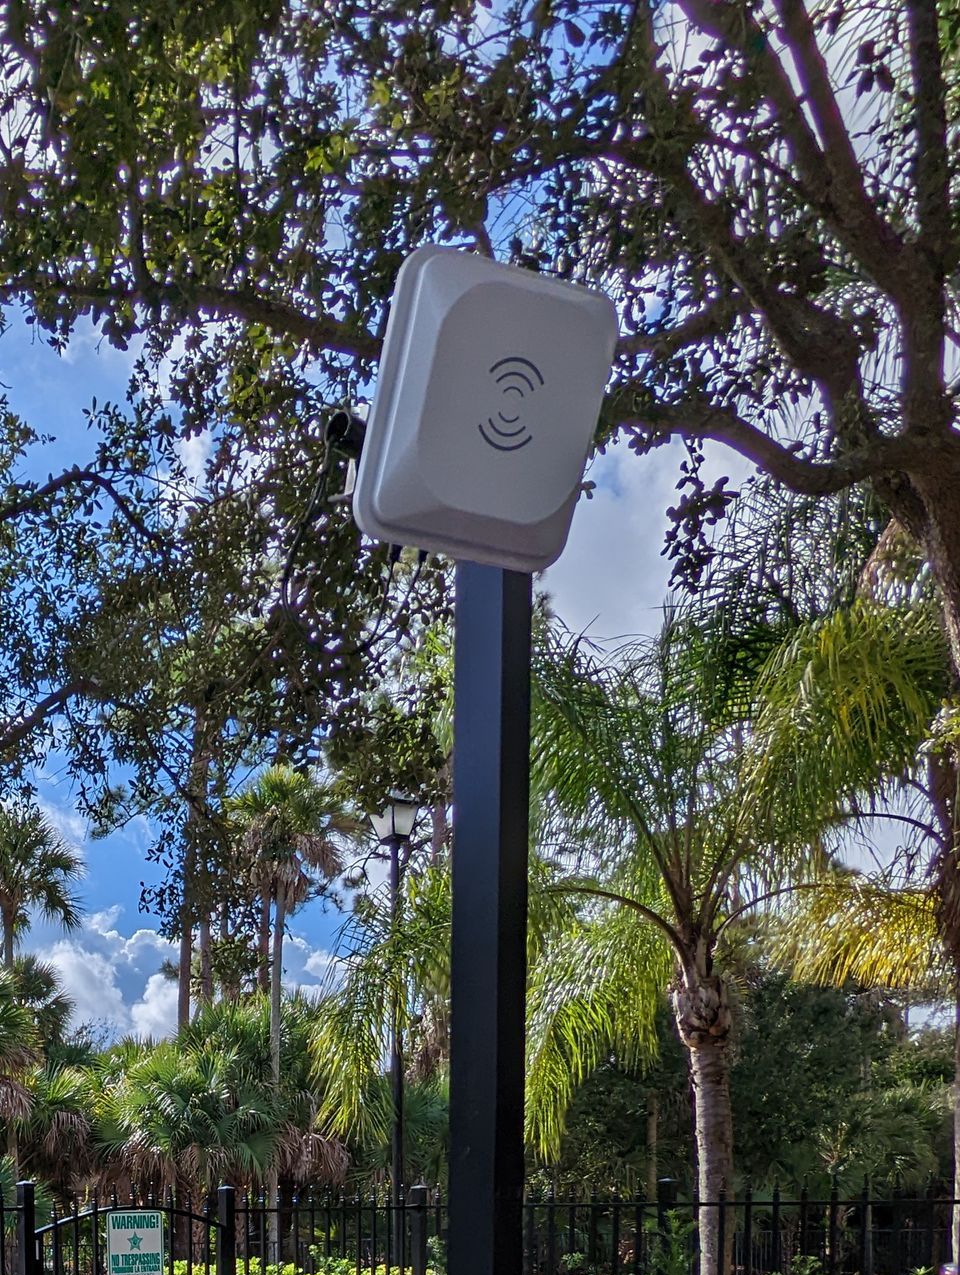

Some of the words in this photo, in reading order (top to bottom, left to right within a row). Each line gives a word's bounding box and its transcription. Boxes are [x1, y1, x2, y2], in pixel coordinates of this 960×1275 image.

[111, 1214, 159, 1230] WARNING!
[111, 1254, 120, 1266] NO
[121, 1252, 160, 1266] TRESPASSING
